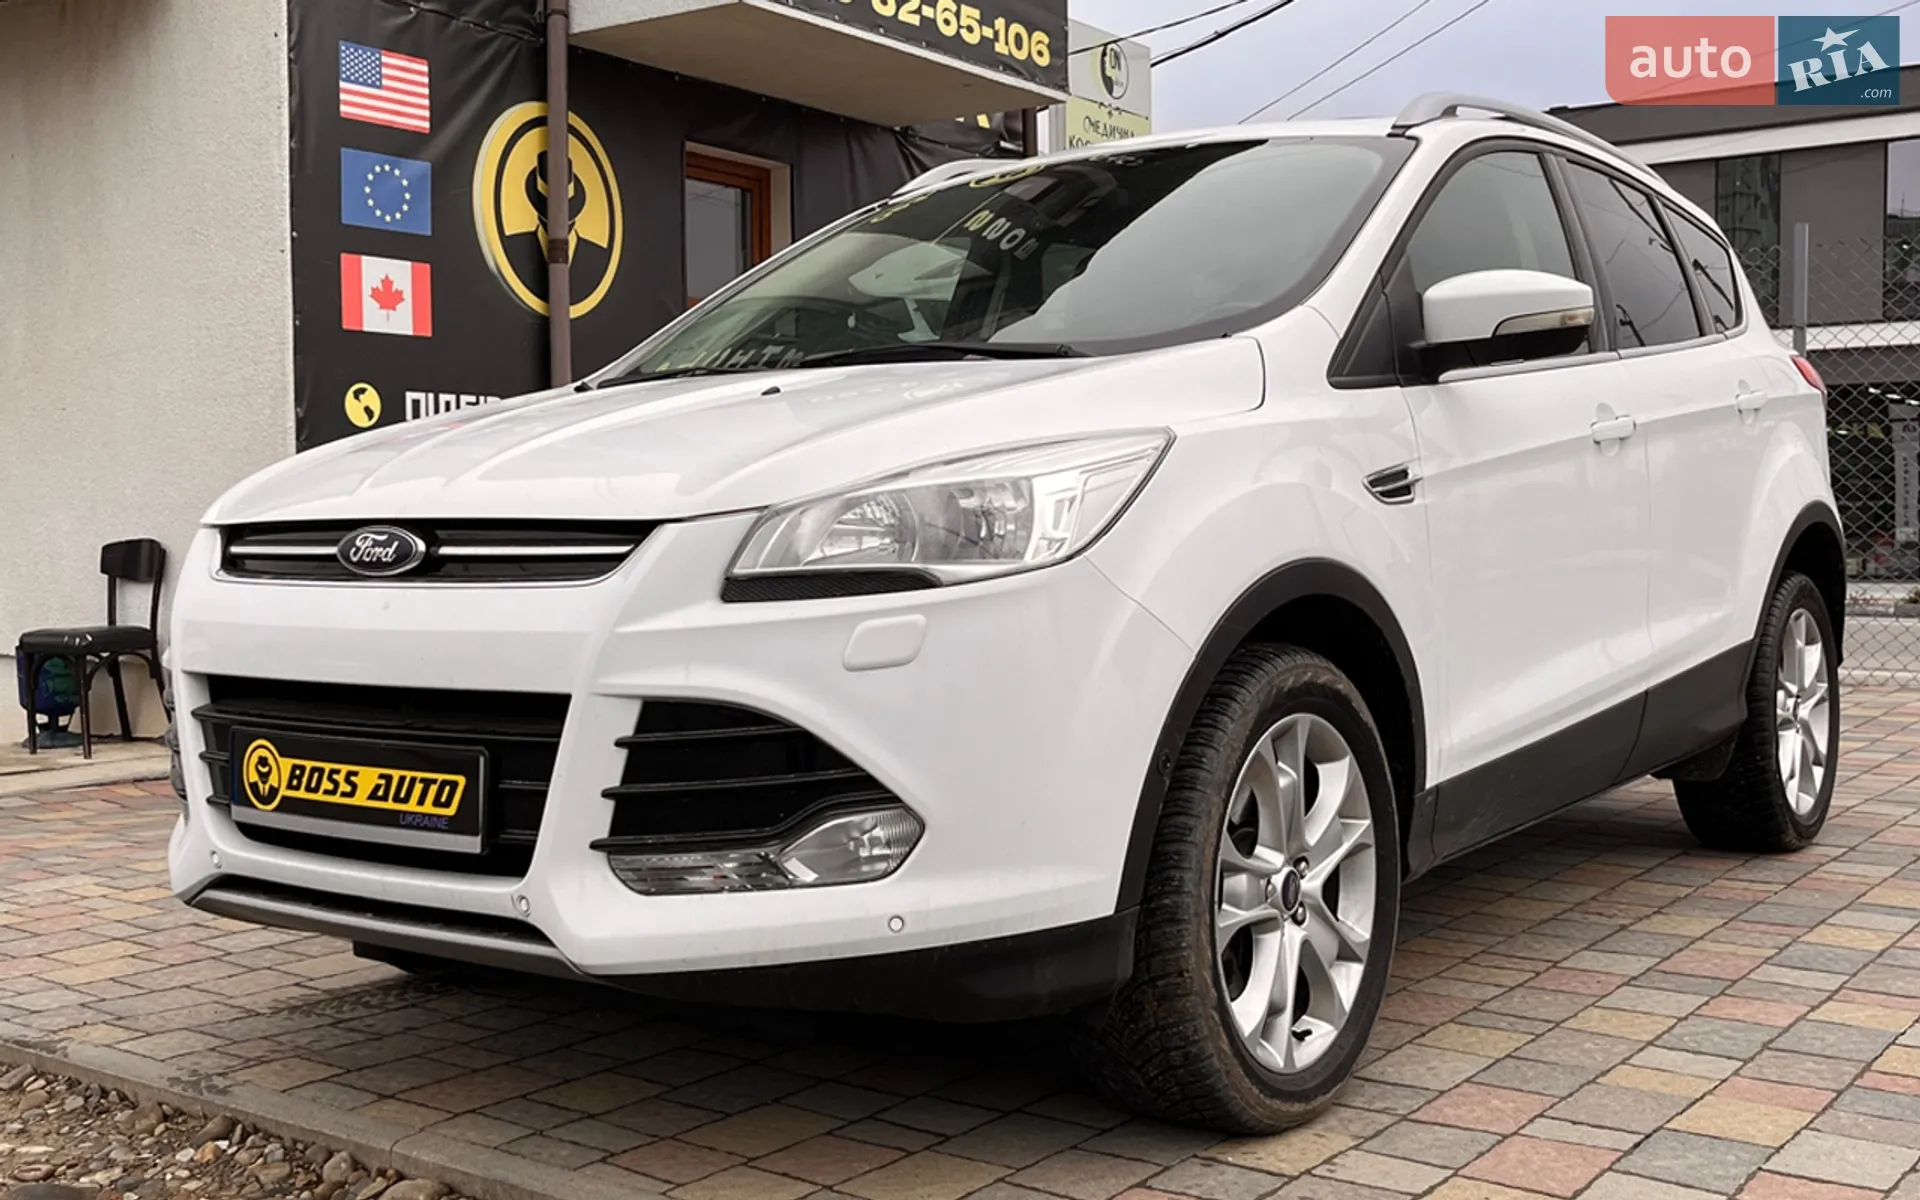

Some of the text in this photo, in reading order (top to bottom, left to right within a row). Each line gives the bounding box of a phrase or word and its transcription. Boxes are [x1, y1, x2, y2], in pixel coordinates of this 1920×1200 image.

[349, 533, 400, 563] Ford
[285, 763, 460, 809] BOSS AUTO
[400, 812, 449, 830] UKRAINE
